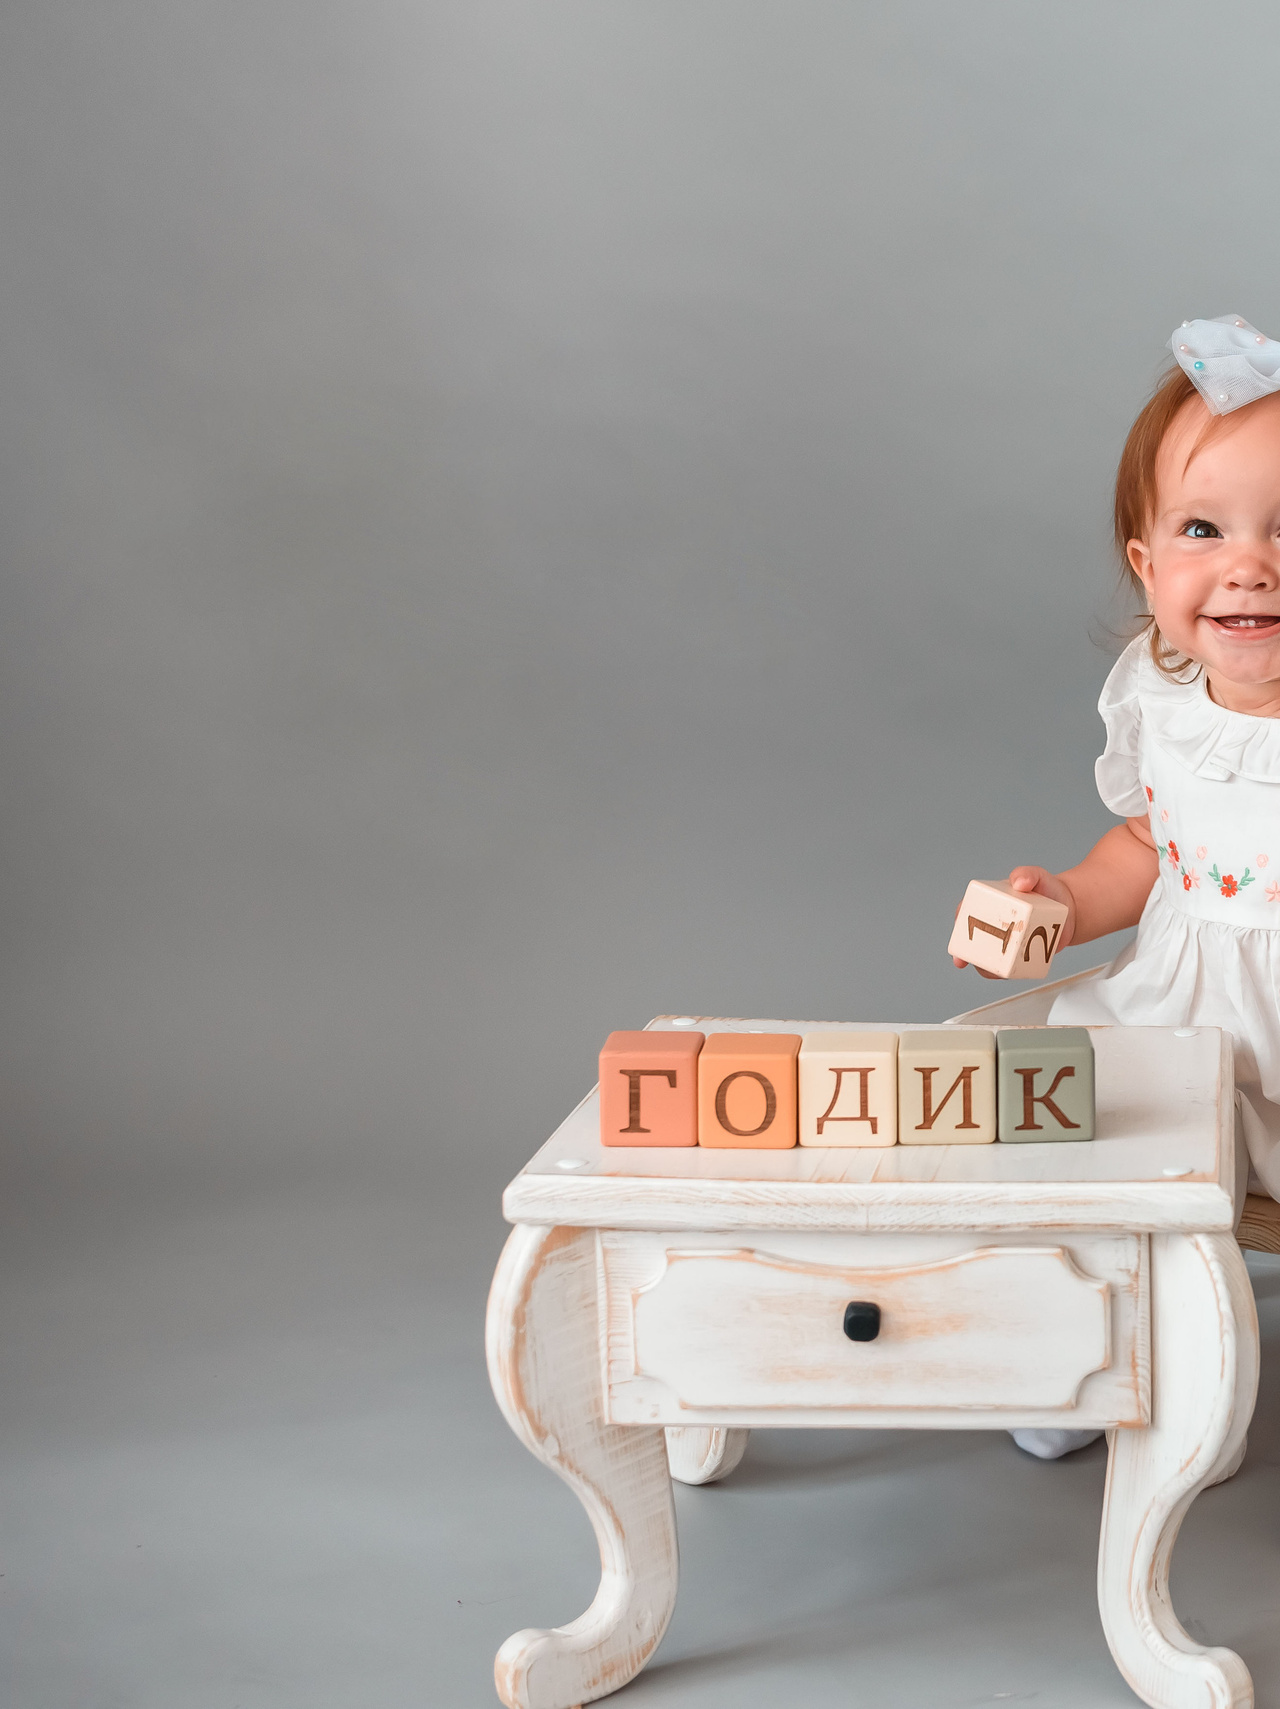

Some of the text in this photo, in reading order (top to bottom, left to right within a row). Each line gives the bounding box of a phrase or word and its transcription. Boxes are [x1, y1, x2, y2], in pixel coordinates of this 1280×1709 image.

[967, 915, 1015, 955] 1
[1023, 923, 1061, 964] 2
[619, 1066, 1081, 1136] ГОДИК
